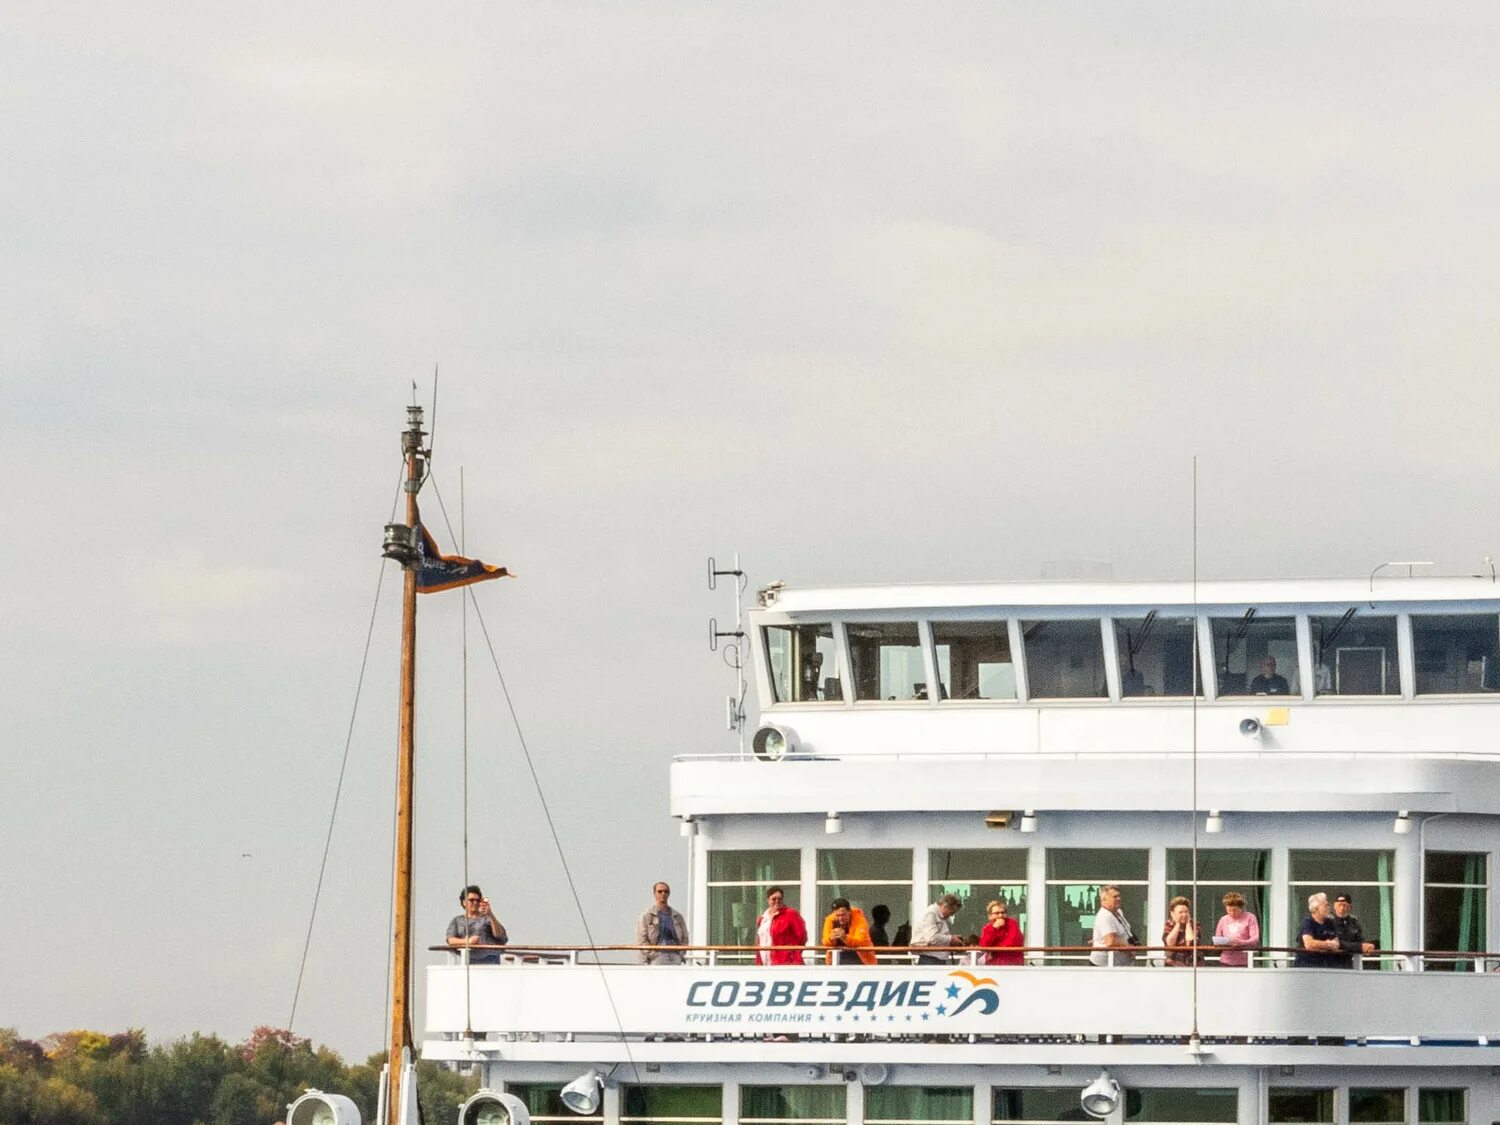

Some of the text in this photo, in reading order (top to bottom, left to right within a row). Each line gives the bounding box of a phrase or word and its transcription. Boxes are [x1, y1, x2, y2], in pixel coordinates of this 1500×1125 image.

[685, 980, 937, 1011] СОЗВЕЗДИЕ
[686, 1013, 812, 1023] КРУИЗНАЯ КОМПАНИЯ
